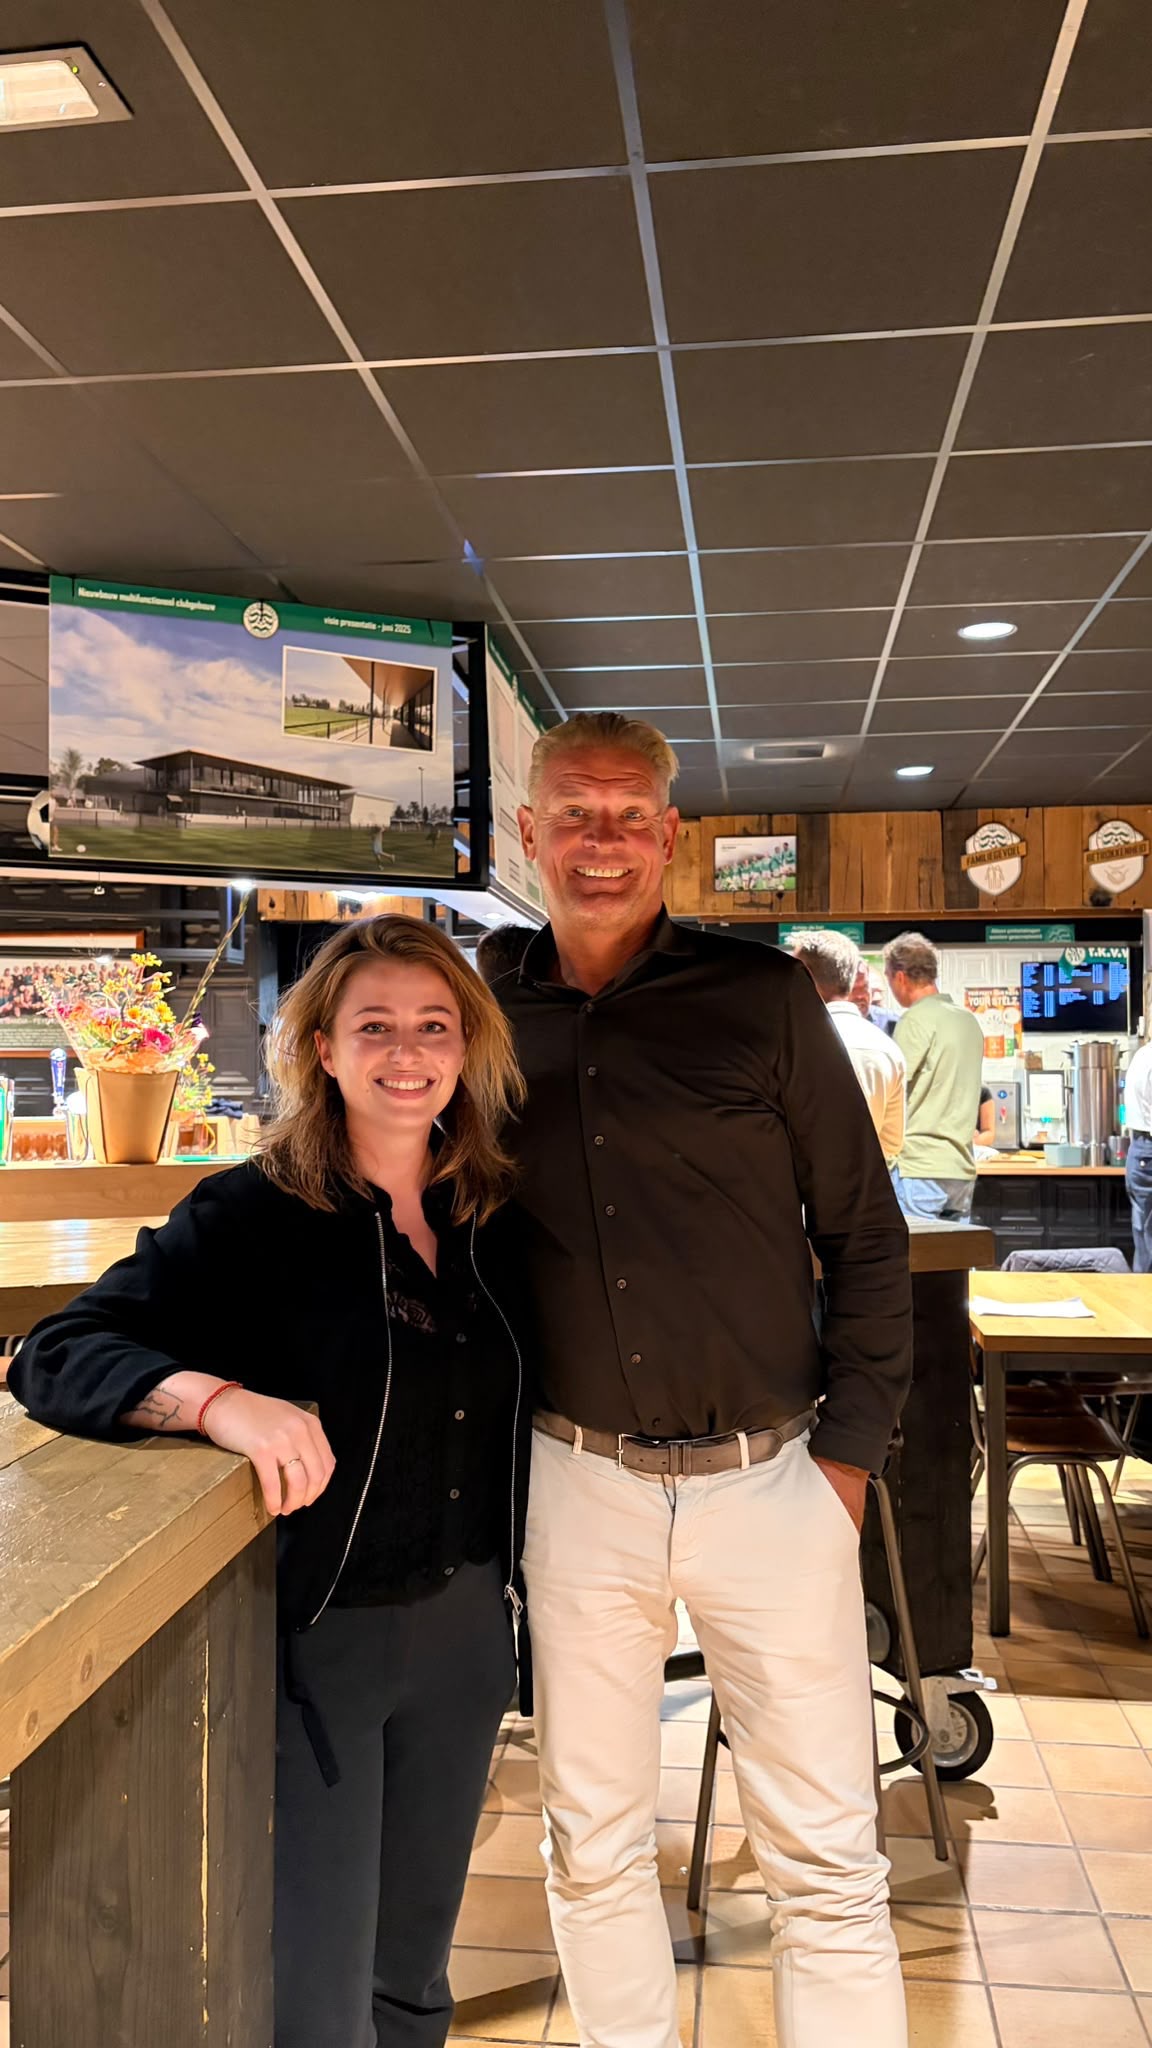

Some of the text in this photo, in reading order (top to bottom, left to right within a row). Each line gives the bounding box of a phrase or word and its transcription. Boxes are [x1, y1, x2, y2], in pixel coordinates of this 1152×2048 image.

[78, 587, 216, 611] Nieuwbouw multifunctioneel clubgebouw
[340, 619, 376, 630] presentatie
[381, 623, 393, 633] juni
[394, 624, 411, 634] 2025
[966, 847, 1021, 867] FAMILIEGEVOEL
[1086, 843, 1146, 863] BETROKKENHEID
